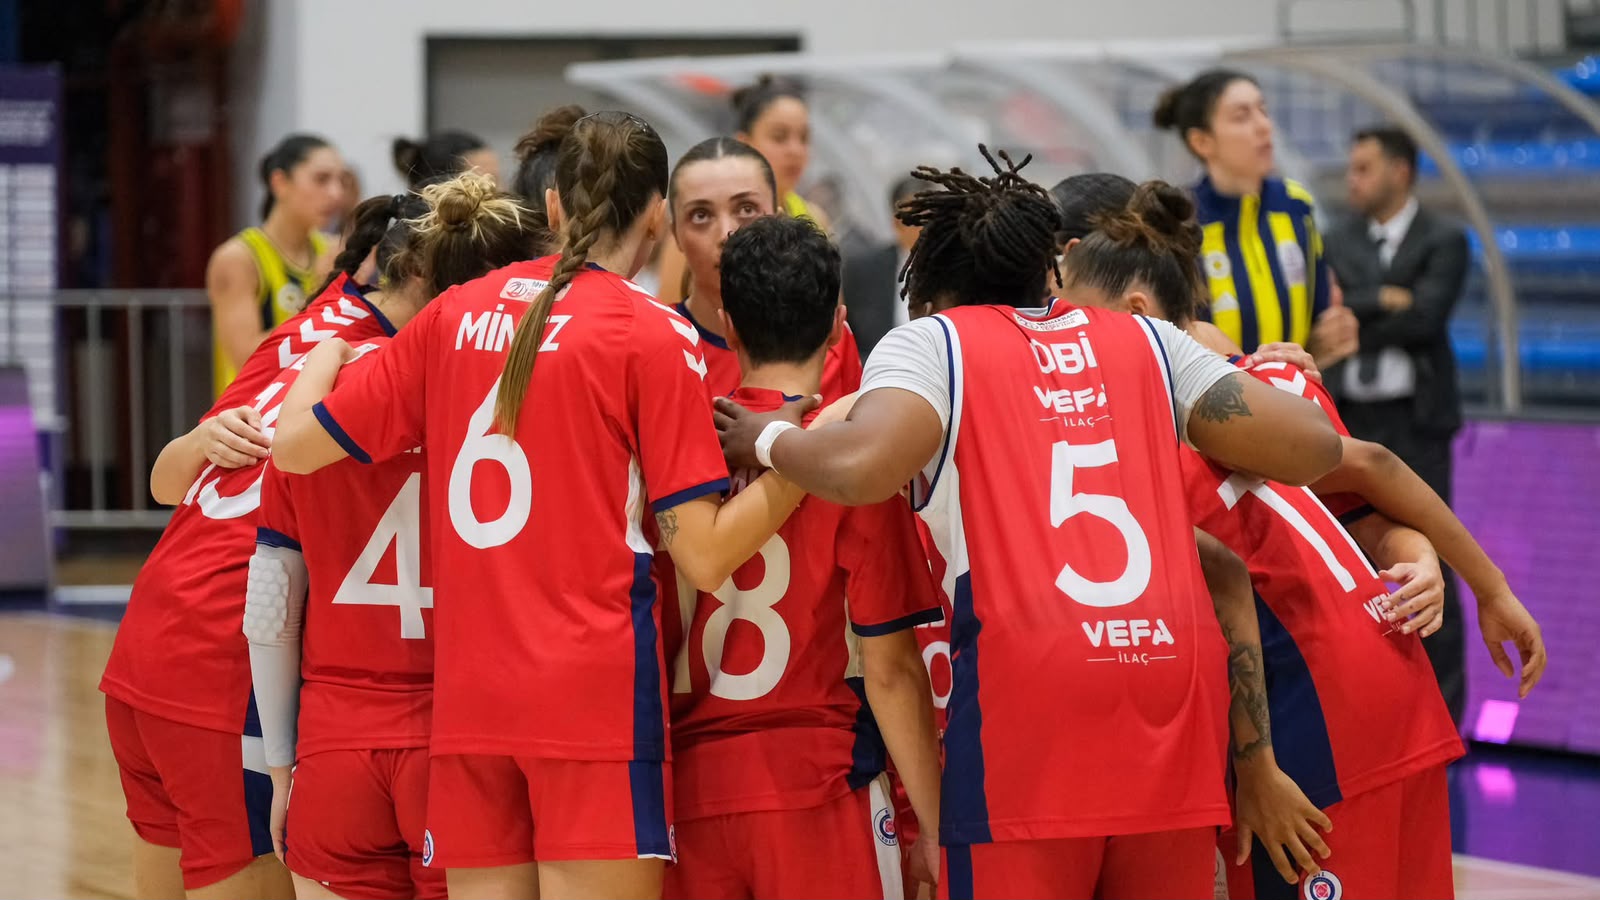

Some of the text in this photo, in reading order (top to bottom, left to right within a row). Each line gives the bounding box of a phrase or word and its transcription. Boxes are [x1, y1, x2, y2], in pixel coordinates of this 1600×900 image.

[455, 303, 573, 352] MİNZ
[448, 373, 532, 549] 6
[1050, 439, 1152, 607] 5
[332, 471, 433, 639] 4
[662, 531, 791, 700] 18
[1081, 618, 1175, 648] VEFA
[1118, 650, 1149, 666] İLAÇ
